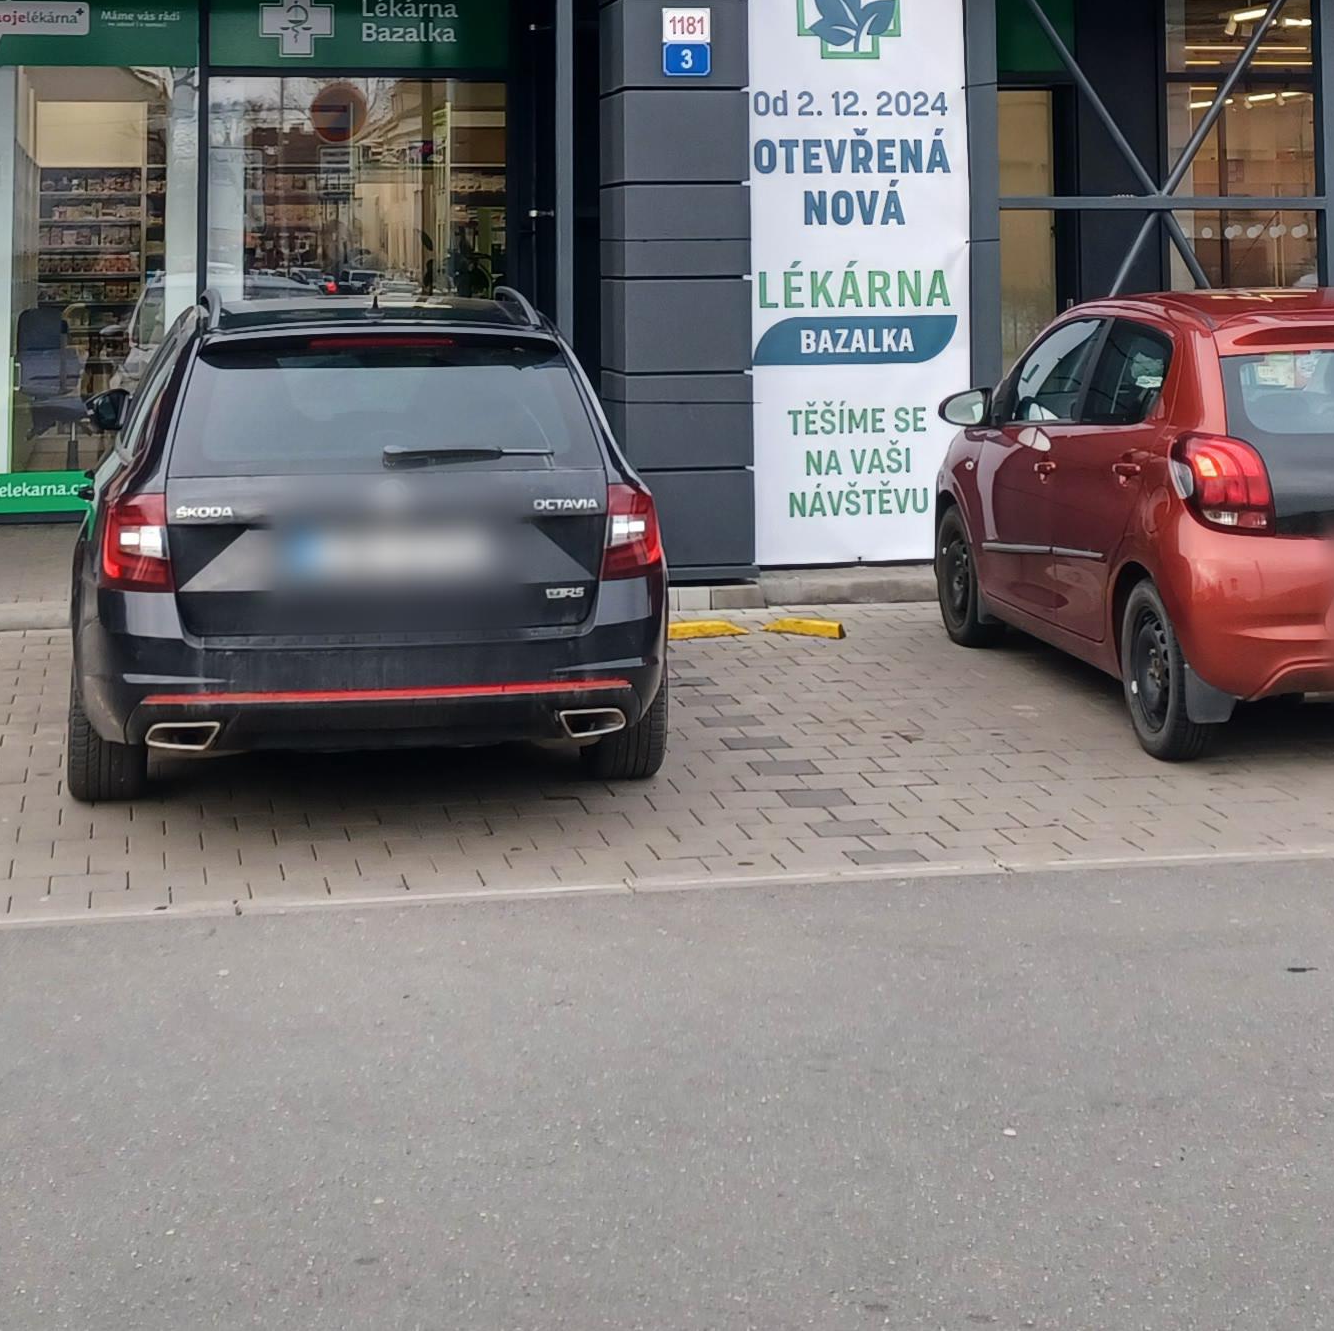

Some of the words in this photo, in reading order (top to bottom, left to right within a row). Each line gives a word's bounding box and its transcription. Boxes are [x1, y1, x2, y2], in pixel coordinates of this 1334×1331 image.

[362, 22, 457, 42] Bazalka
[669, 16, 705, 35] 1181
[681, 49, 693, 69] 3
[754, 90, 788, 116] Od
[797, 91, 822, 116] 2.
[831, 91, 867, 116] 12.
[876, 91, 948, 116] 2024
[753, 128, 951, 174] OTEVŘENÁ
[804, 180, 906, 226] NOVÁ
[758, 260, 951, 309] LÉKÁRNA
[800, 328, 915, 354] BAZALKA
[788, 401, 885, 435] TĚŠÍME
[894, 407, 927, 433] SE
[806, 450, 842, 476] NA
[851, 440, 911, 474] VAŠI
[176, 505, 233, 518] ŠKODA
[533, 498, 599, 510] OCTAVIA
[789, 480, 929, 517] NÁVŠTĚVU
